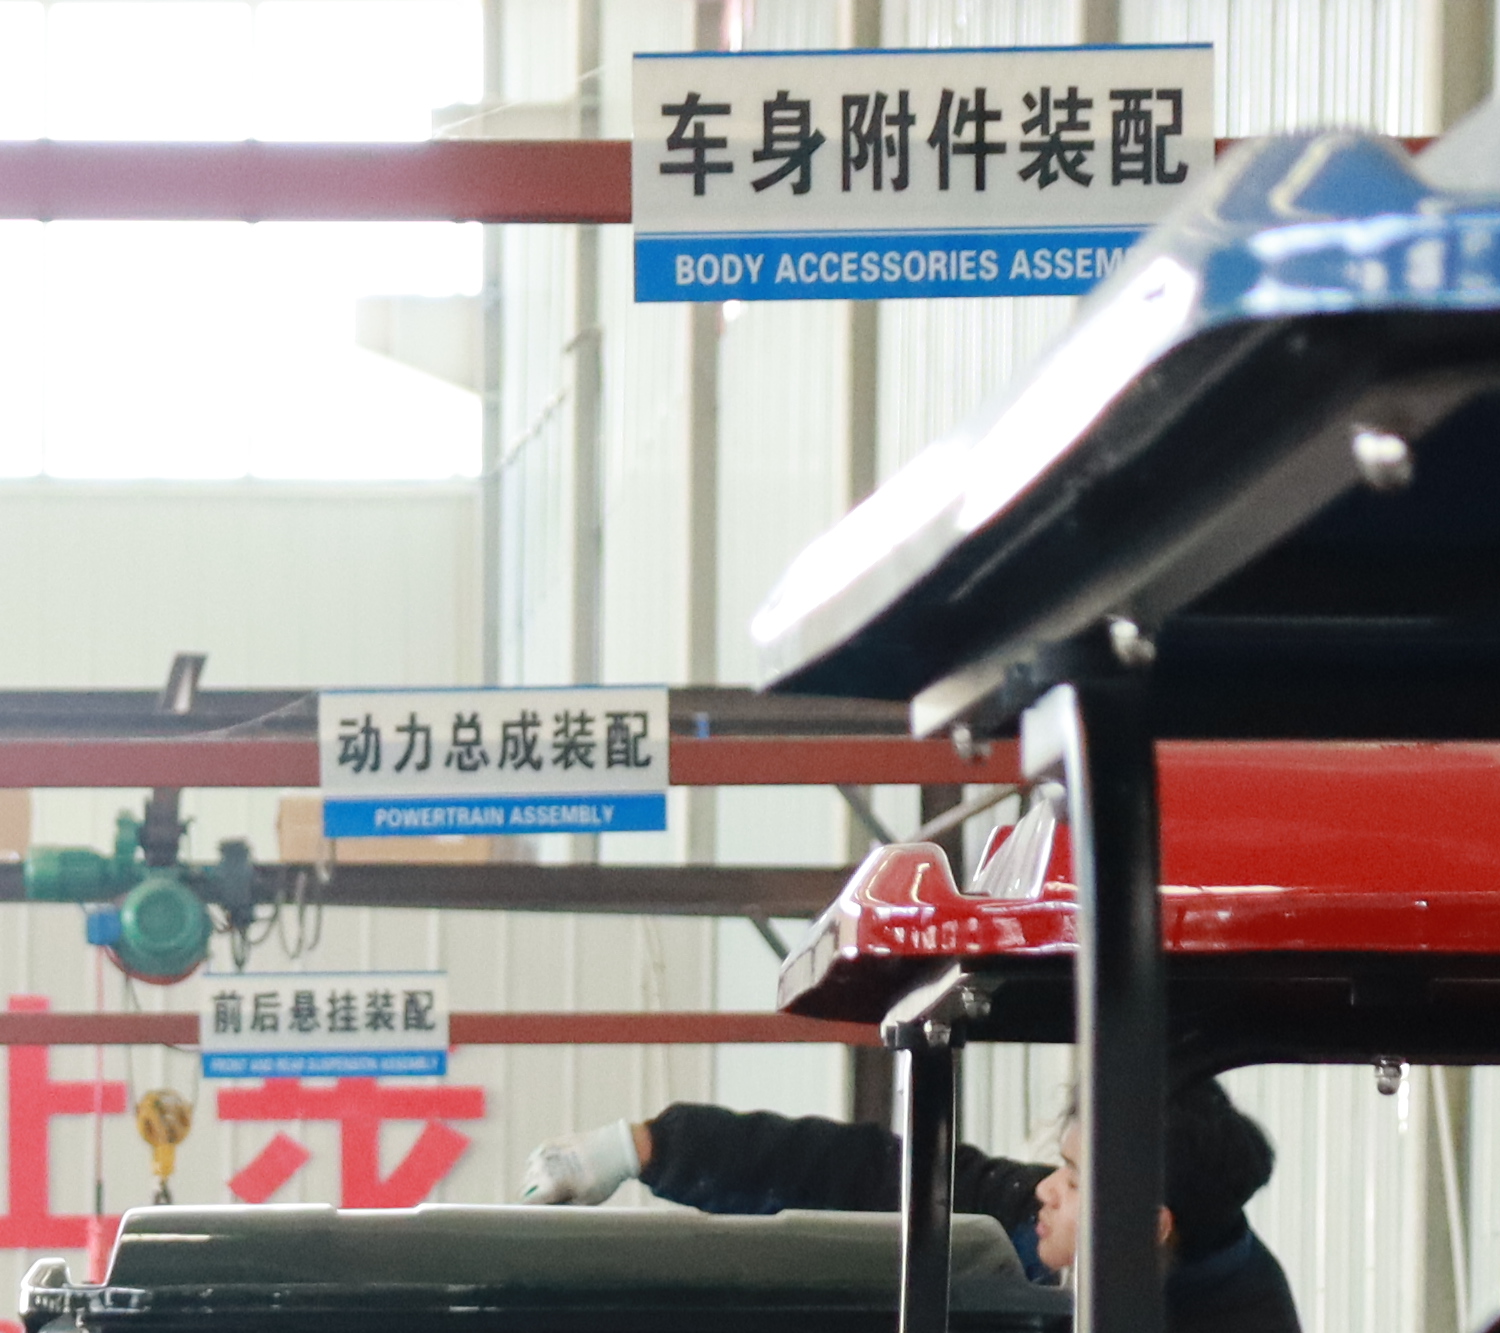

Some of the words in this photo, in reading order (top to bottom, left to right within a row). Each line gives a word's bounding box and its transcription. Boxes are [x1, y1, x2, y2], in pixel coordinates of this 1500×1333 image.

[658, 86, 1189, 196] 车身附件装配
[674, 254, 764, 286] BODY
[774, 249, 999, 284] ACCESSORIES
[1008, 246, 1126, 281] ASSEM
[337, 710, 652, 774] 动力总成装配
[374, 807, 505, 827] POWERTRAIN
[509, 805, 615, 825] ASSEMBLY
[213, 990, 435, 1033] 前后悬挂装配
